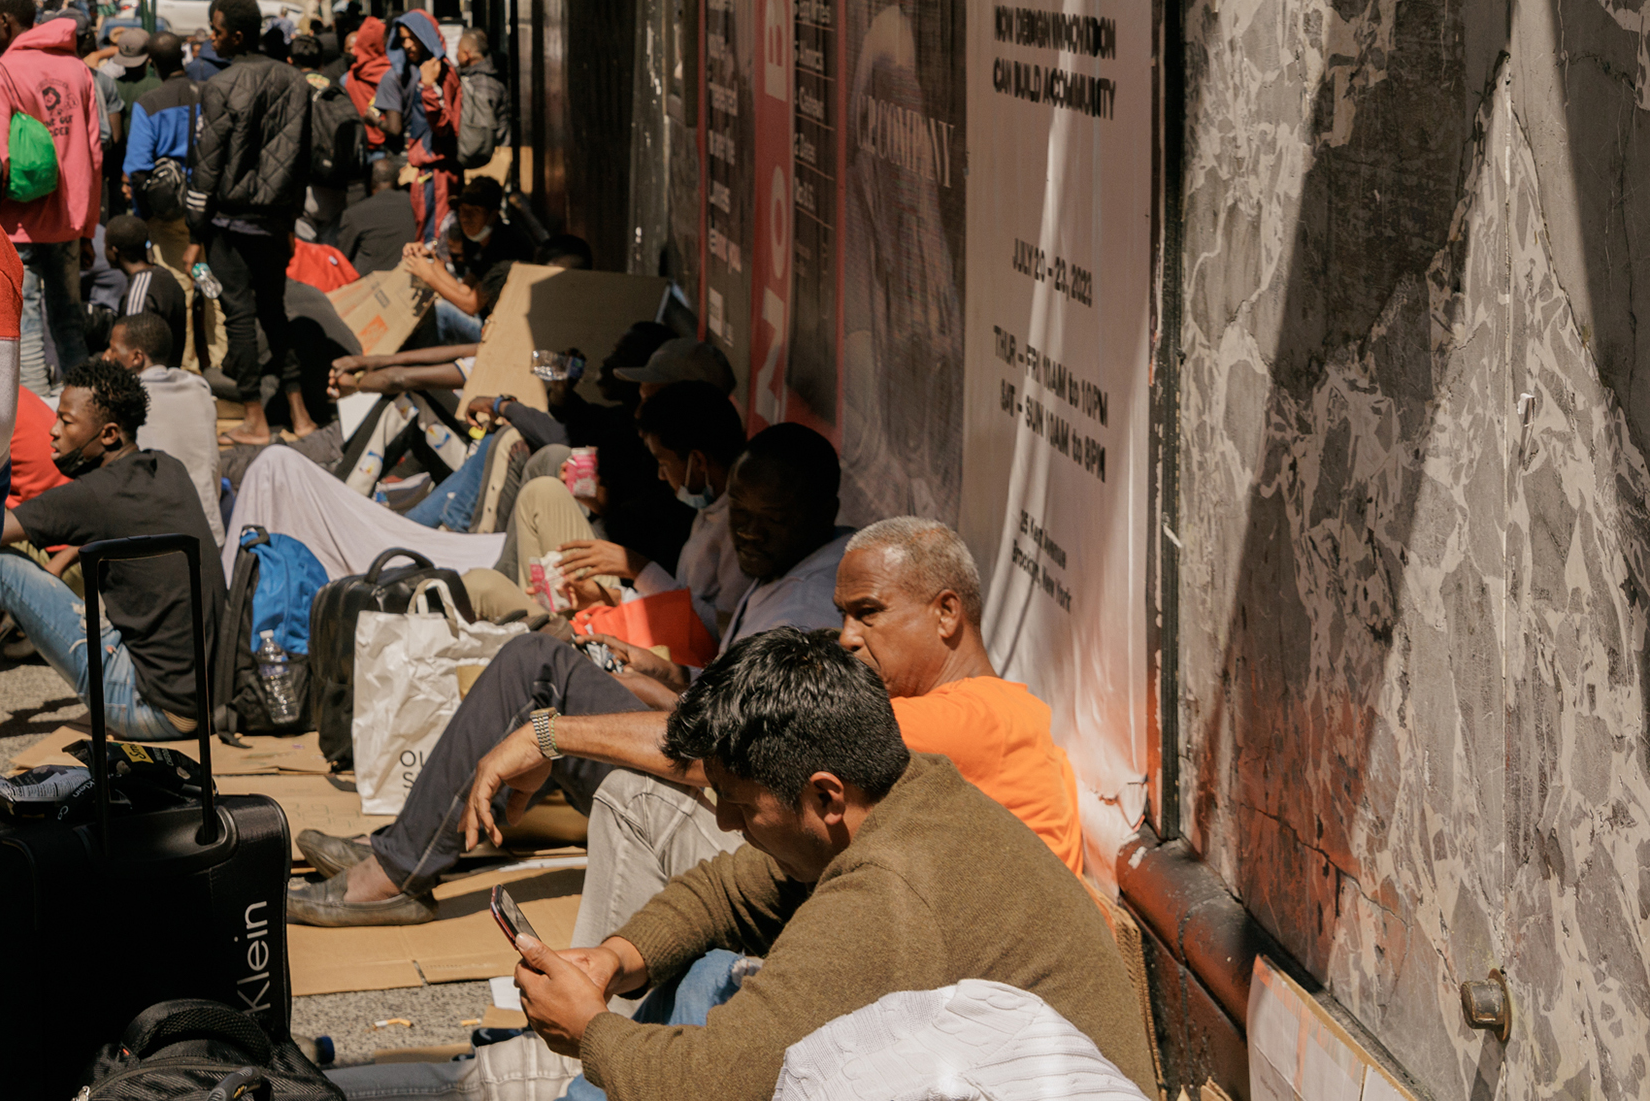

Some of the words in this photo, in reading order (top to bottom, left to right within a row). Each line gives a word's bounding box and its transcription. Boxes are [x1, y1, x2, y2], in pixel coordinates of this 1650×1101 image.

[1012, 238, 1034, 276] JULY
[993, 325, 1017, 368] THUR
[234, 900, 270, 1014] Klein
